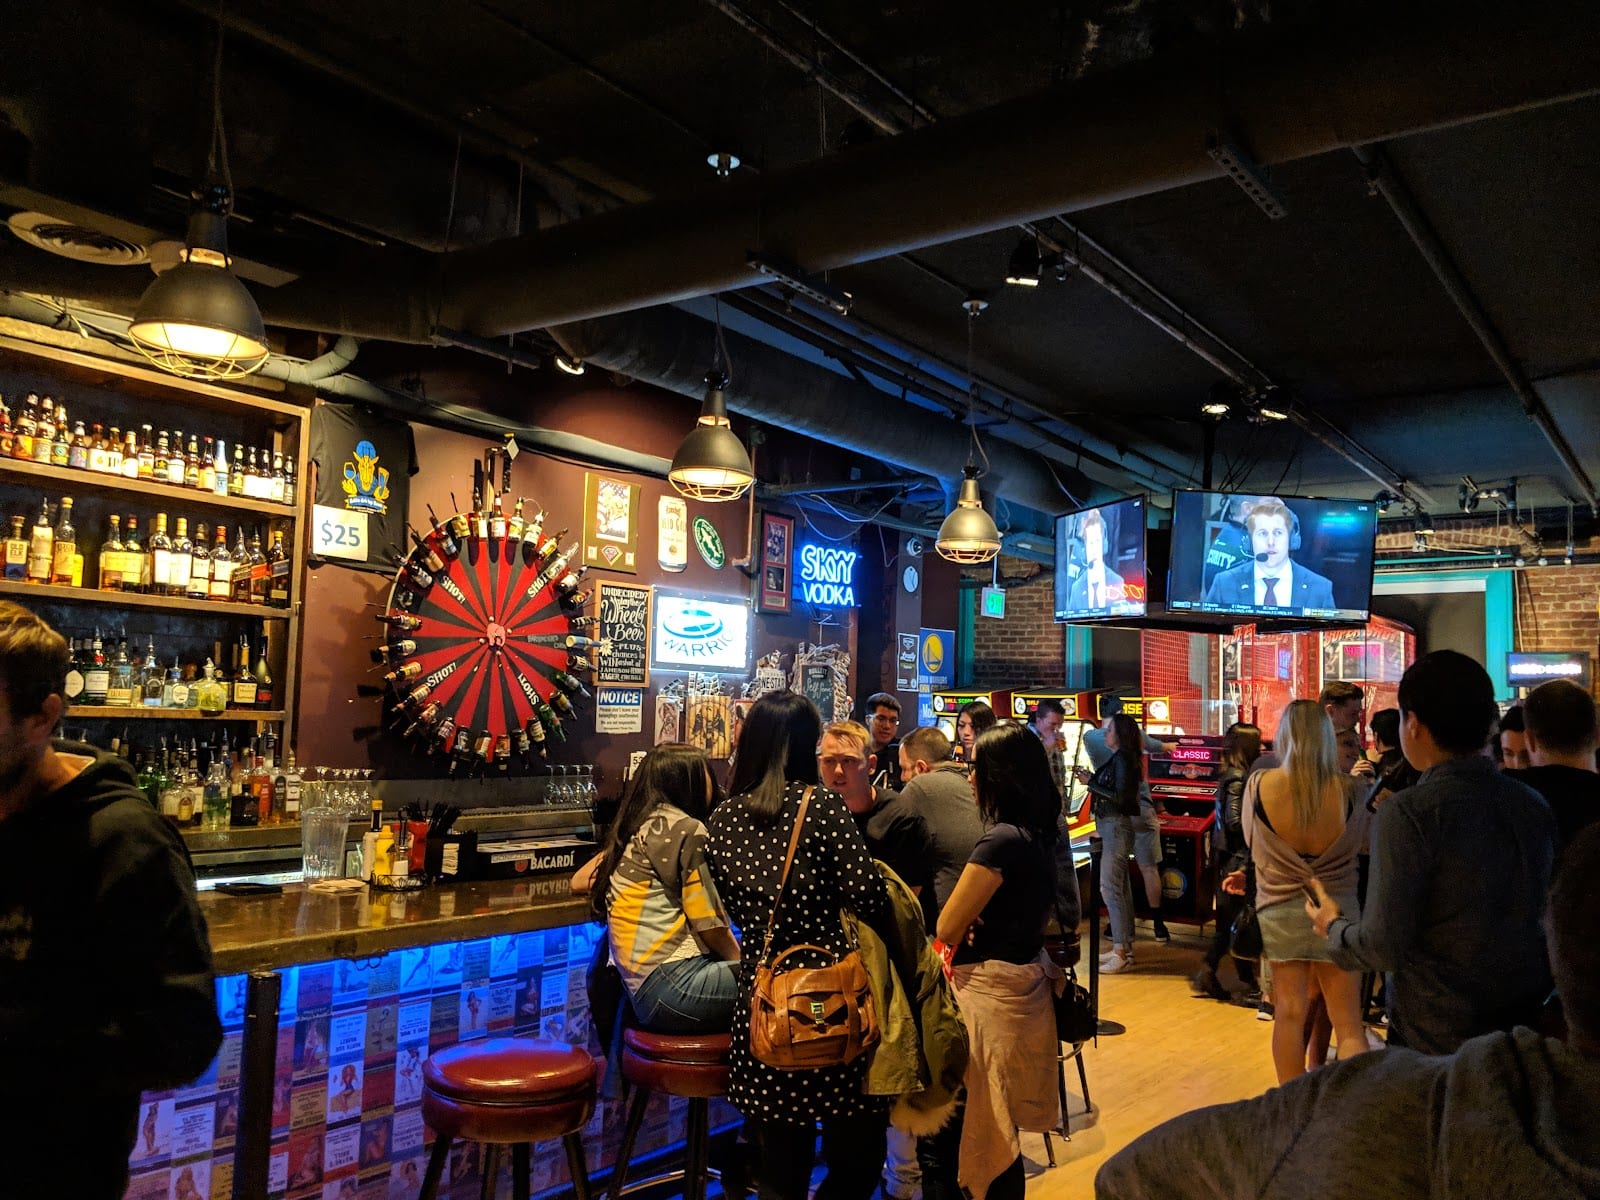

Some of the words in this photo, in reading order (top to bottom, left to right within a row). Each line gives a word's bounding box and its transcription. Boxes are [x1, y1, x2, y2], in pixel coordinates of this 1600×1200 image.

[321, 520, 361, 547] $25
[801, 544, 857, 585] SKYY
[441, 575, 466, 604] SHOT!
[602, 586, 648, 601] UNDECIDED?
[802, 582, 855, 606] VODKA
[427, 662, 457, 688] SHOT!
[517, 672, 540, 706] SHOT!
[599, 690, 640, 704] NOTICE
[1173, 750, 1210, 760] CLASSIC
[530, 850, 575, 870] BACARDÍ
